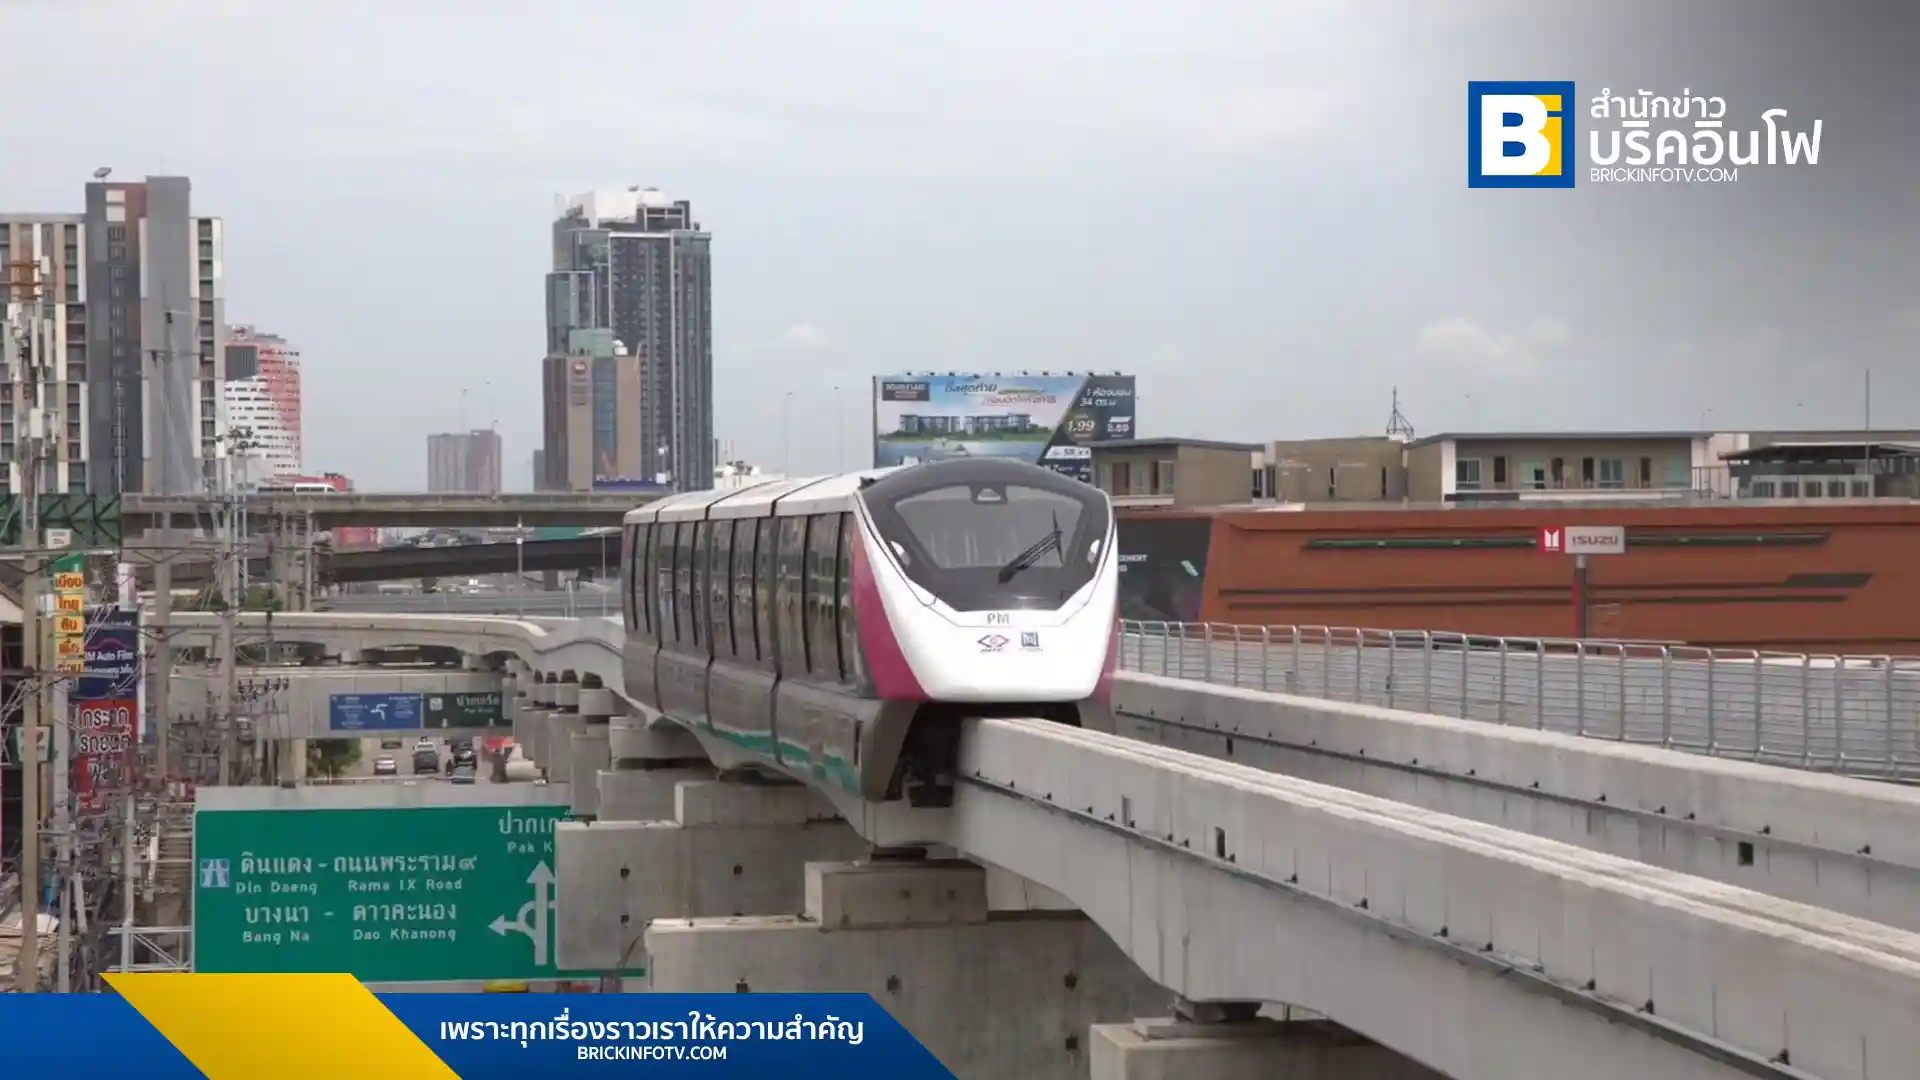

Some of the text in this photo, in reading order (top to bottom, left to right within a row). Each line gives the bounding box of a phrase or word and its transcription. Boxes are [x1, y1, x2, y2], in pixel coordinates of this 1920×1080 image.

[1066, 418, 1096, 433] 1.99
[1572, 535, 1620, 546] ISUZU
[508, 842, 534, 853] Pak
[242, 852, 311, 873] ดินแดง
[236, 878, 462, 895] Din Daeng Rama IX Road
[246, 907, 308, 923] บางนา
[354, 904, 455, 921] ดาวคะนอง
[243, 928, 456, 944] Bang Na Dao Khanong
